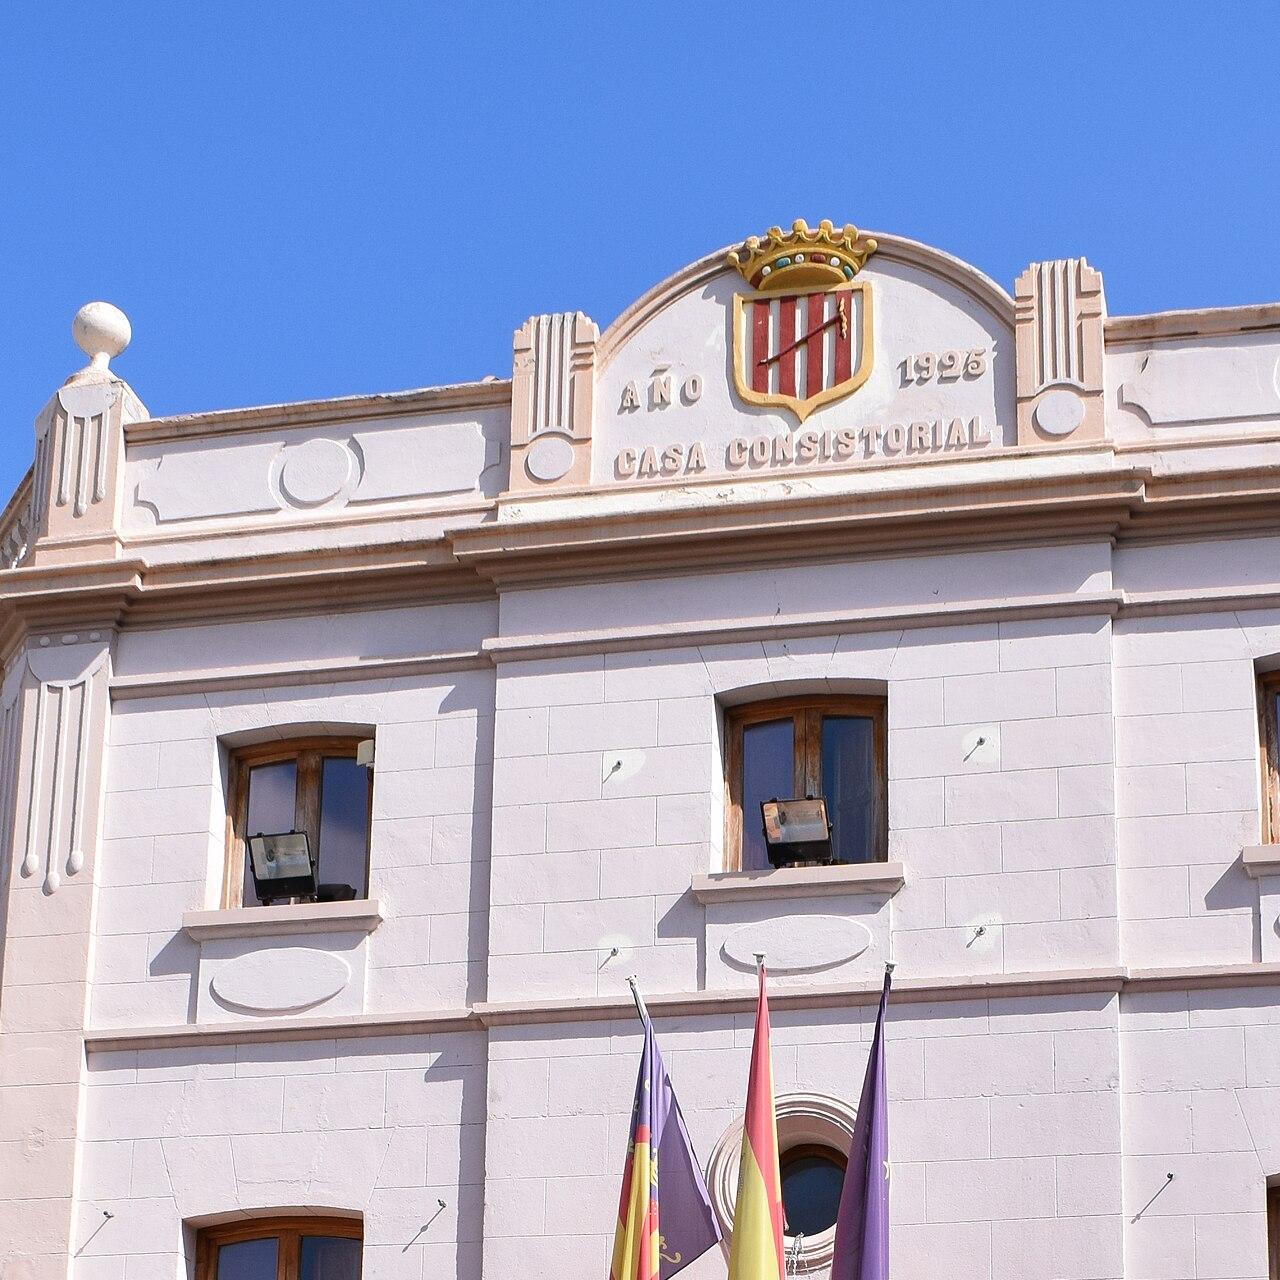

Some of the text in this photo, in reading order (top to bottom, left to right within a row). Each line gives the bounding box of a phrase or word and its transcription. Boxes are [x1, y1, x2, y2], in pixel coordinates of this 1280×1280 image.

[619, 364, 703, 412] AÑO
[898, 347, 987, 387] 1925
[616, 416, 992, 479] CASA CONSISTORIAL
